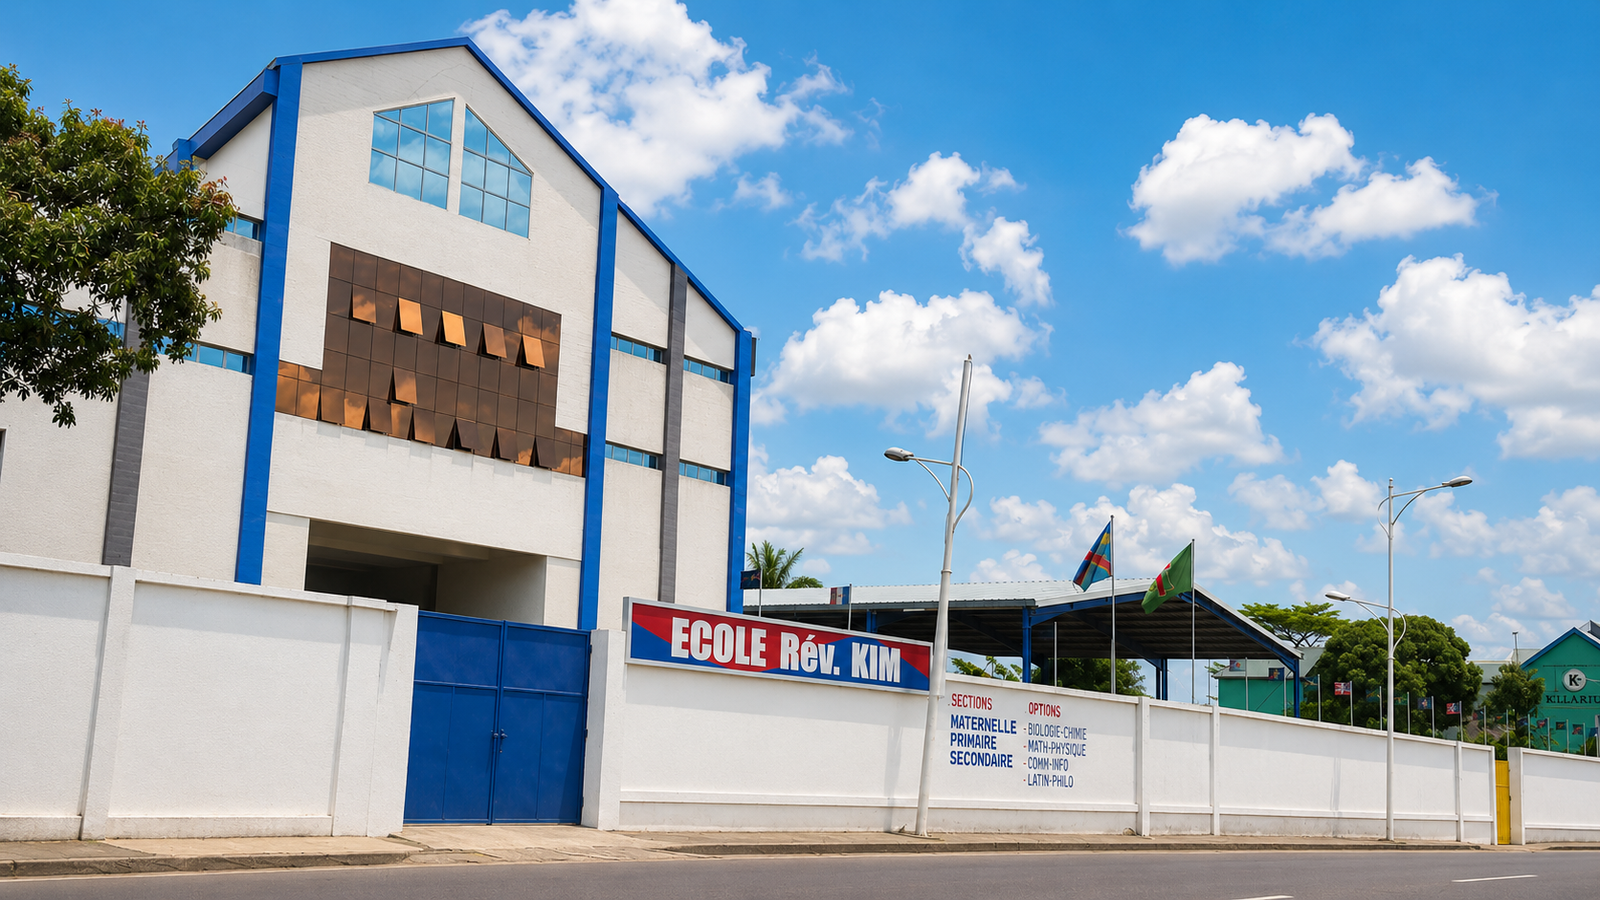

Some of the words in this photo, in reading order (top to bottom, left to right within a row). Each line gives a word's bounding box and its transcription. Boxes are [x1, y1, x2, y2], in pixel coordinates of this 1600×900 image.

[671, 616, 767, 668] ECOLE
[780, 631, 840, 676] Rév.
[851, 641, 901, 683] KIM
[951, 693, 993, 711] SECTIONS
[1028, 702, 1061, 718] OPTIONS
[950, 714, 1017, 735] MATERNELLE
[950, 732, 997, 750] PRIMAIRE
[950, 751, 1013, 768] SECONDAIRE
